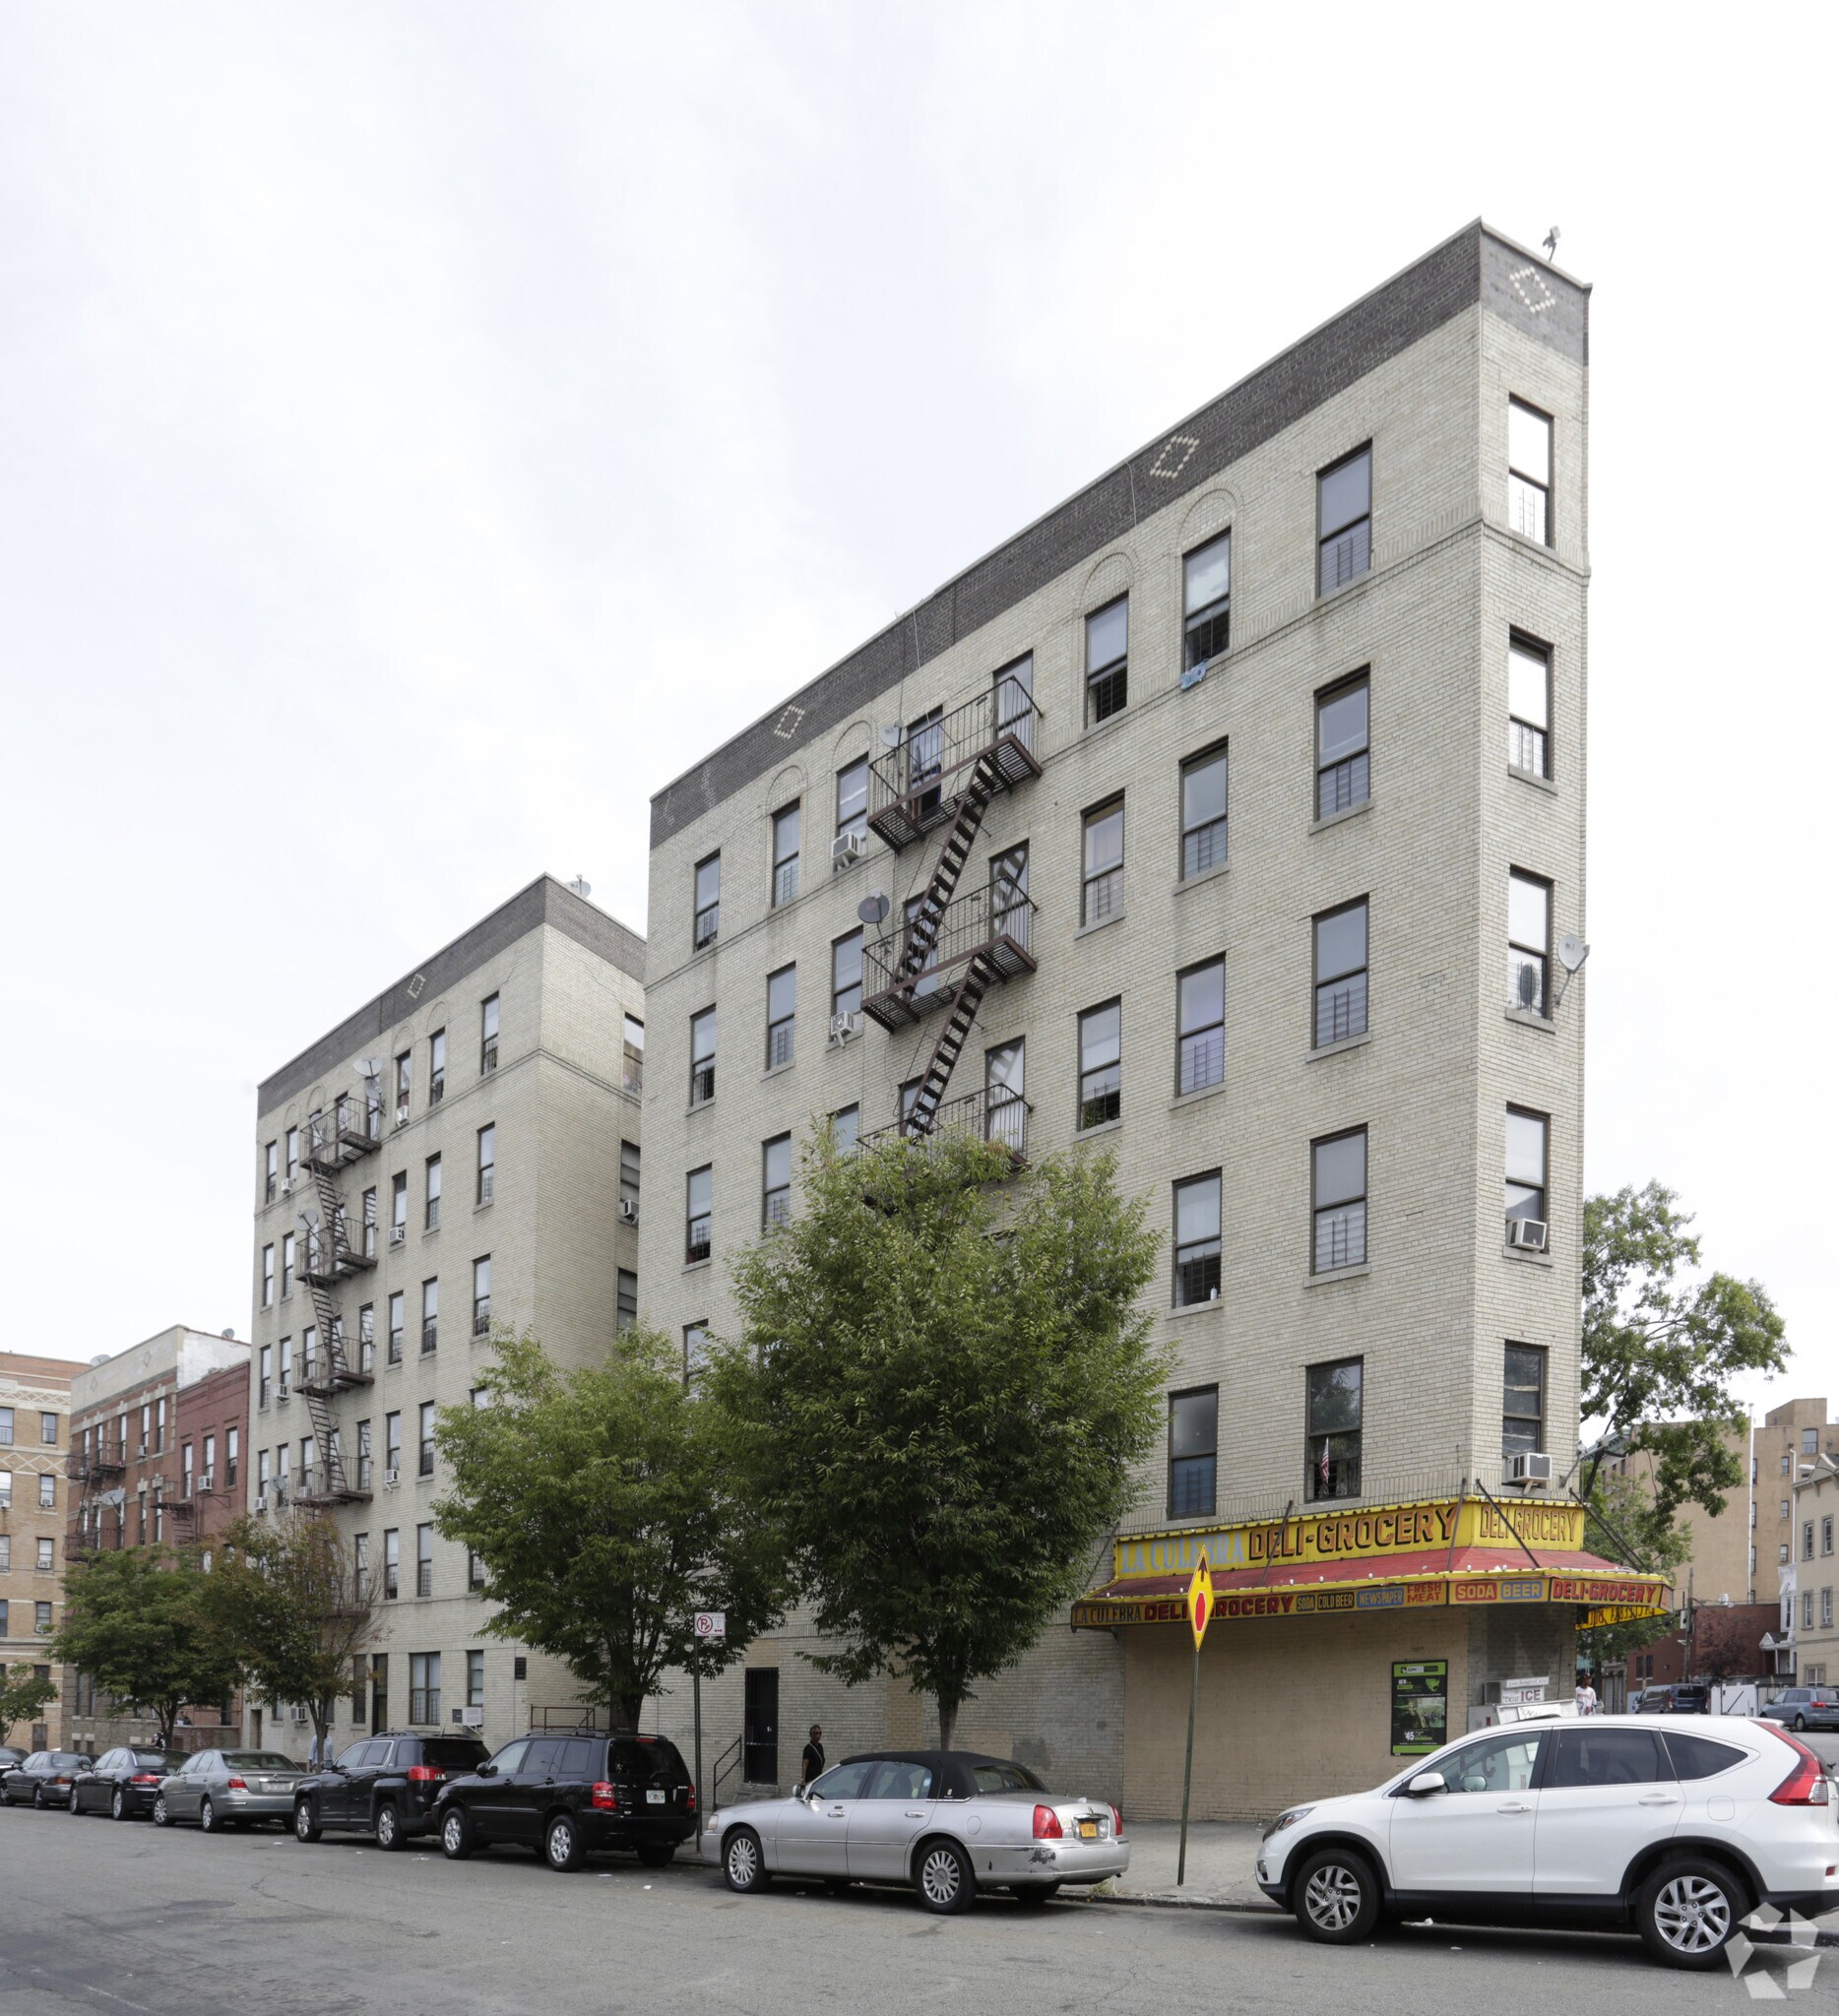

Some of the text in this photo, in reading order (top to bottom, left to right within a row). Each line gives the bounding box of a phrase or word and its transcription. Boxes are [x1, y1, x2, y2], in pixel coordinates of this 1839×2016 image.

[1120, 1543, 1145, 1573] LA
[1150, 1532, 1244, 1571] CULEBRA
[1408, 1582, 1441, 1593] FRESH
[1457, 1584, 1541, 1599] SODA BEER
[1408, 1592, 1440, 1603] MEAT
[1074, 1606, 1088, 1624] LA
[1091, 1605, 1142, 1624] CULEBRA
[1297, 1596, 1314, 1609] SODA
[1319, 1594, 1335, 1608] COLD
[1336, 1593, 1354, 1607] BEER
[1359, 1590, 1402, 1606] NEWSPAPER
[1520, 1689, 1542, 1702] ICE
